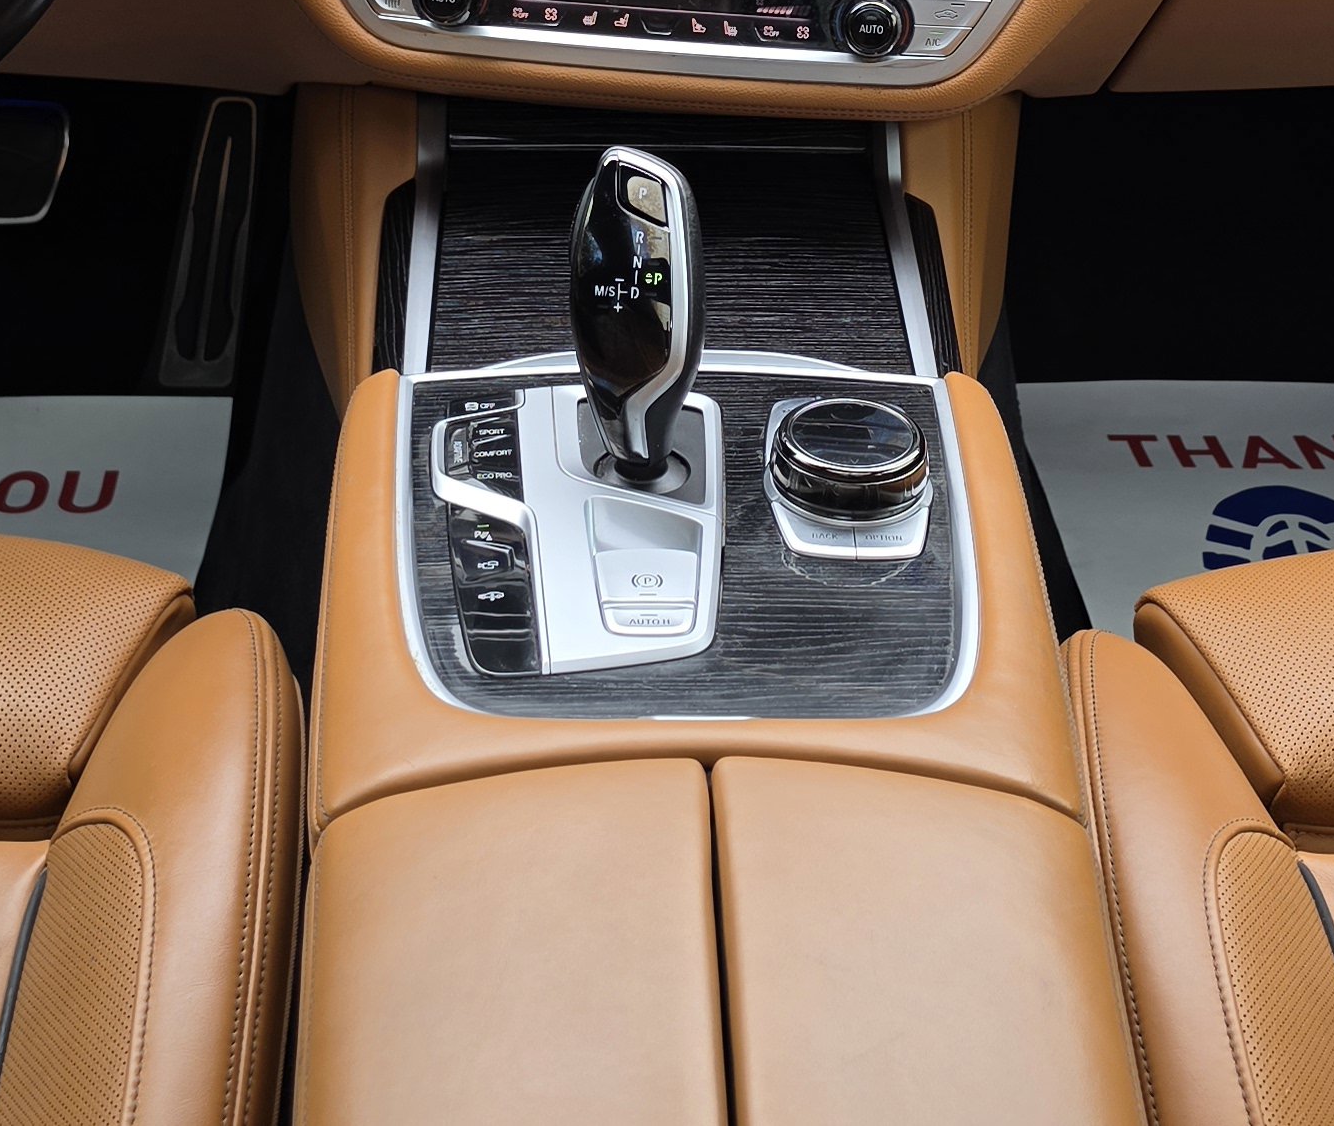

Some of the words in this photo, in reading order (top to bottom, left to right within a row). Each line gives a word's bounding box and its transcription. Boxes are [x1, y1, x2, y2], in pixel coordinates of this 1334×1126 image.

[858, 24, 884, 36] AUTO
[925, 37, 942, 48] A/C
[638, 187, 648, 200] P
[635, 230, 645, 244] R
[632, 255, 643, 269] N
[653, 272, 663, 285] P
[594, 285, 616, 297] M/S
[630, 286, 640, 299] D
[478, 428, 505, 436] SPORT
[473, 448, 513, 459] COMFORT
[476, 472, 494, 480] ECO
[495, 471, 513, 479] PRO
[811, 532, 839, 541] BACK
[865, 534, 903, 542] OPTION
